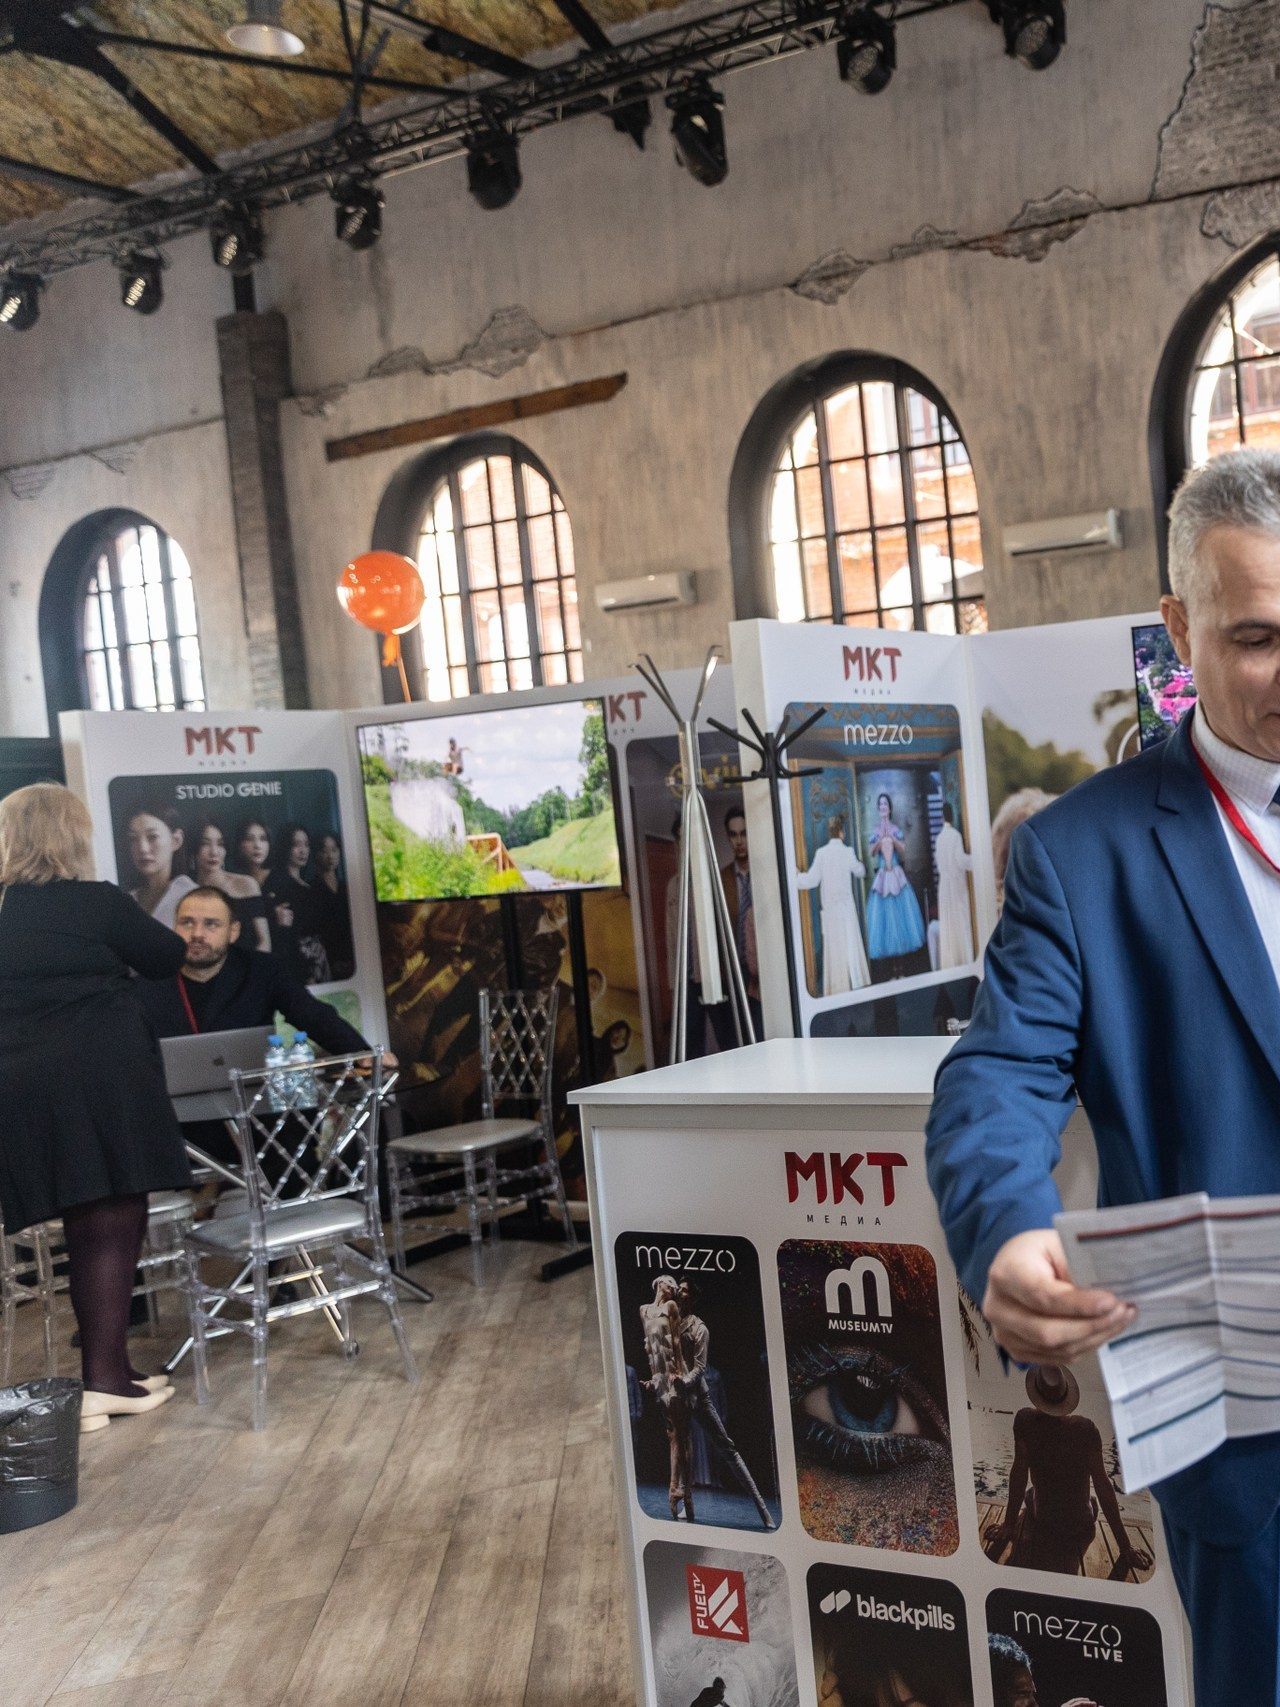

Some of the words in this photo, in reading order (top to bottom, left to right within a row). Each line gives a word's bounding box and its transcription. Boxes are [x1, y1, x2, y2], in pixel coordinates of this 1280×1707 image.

[608, 691, 648, 724] КТ
[843, 723, 914, 746] mezzo
[175, 783, 235, 800] STUDIO
[236, 781, 282, 798] GENIE
[806, 1214, 881, 1227] МЕДИА
[635, 1245, 736, 1273] mezzo
[856, 1593, 956, 1631] blackpills
[1013, 1610, 1122, 1647] mezzo
[1083, 1644, 1123, 1663] LIVE
